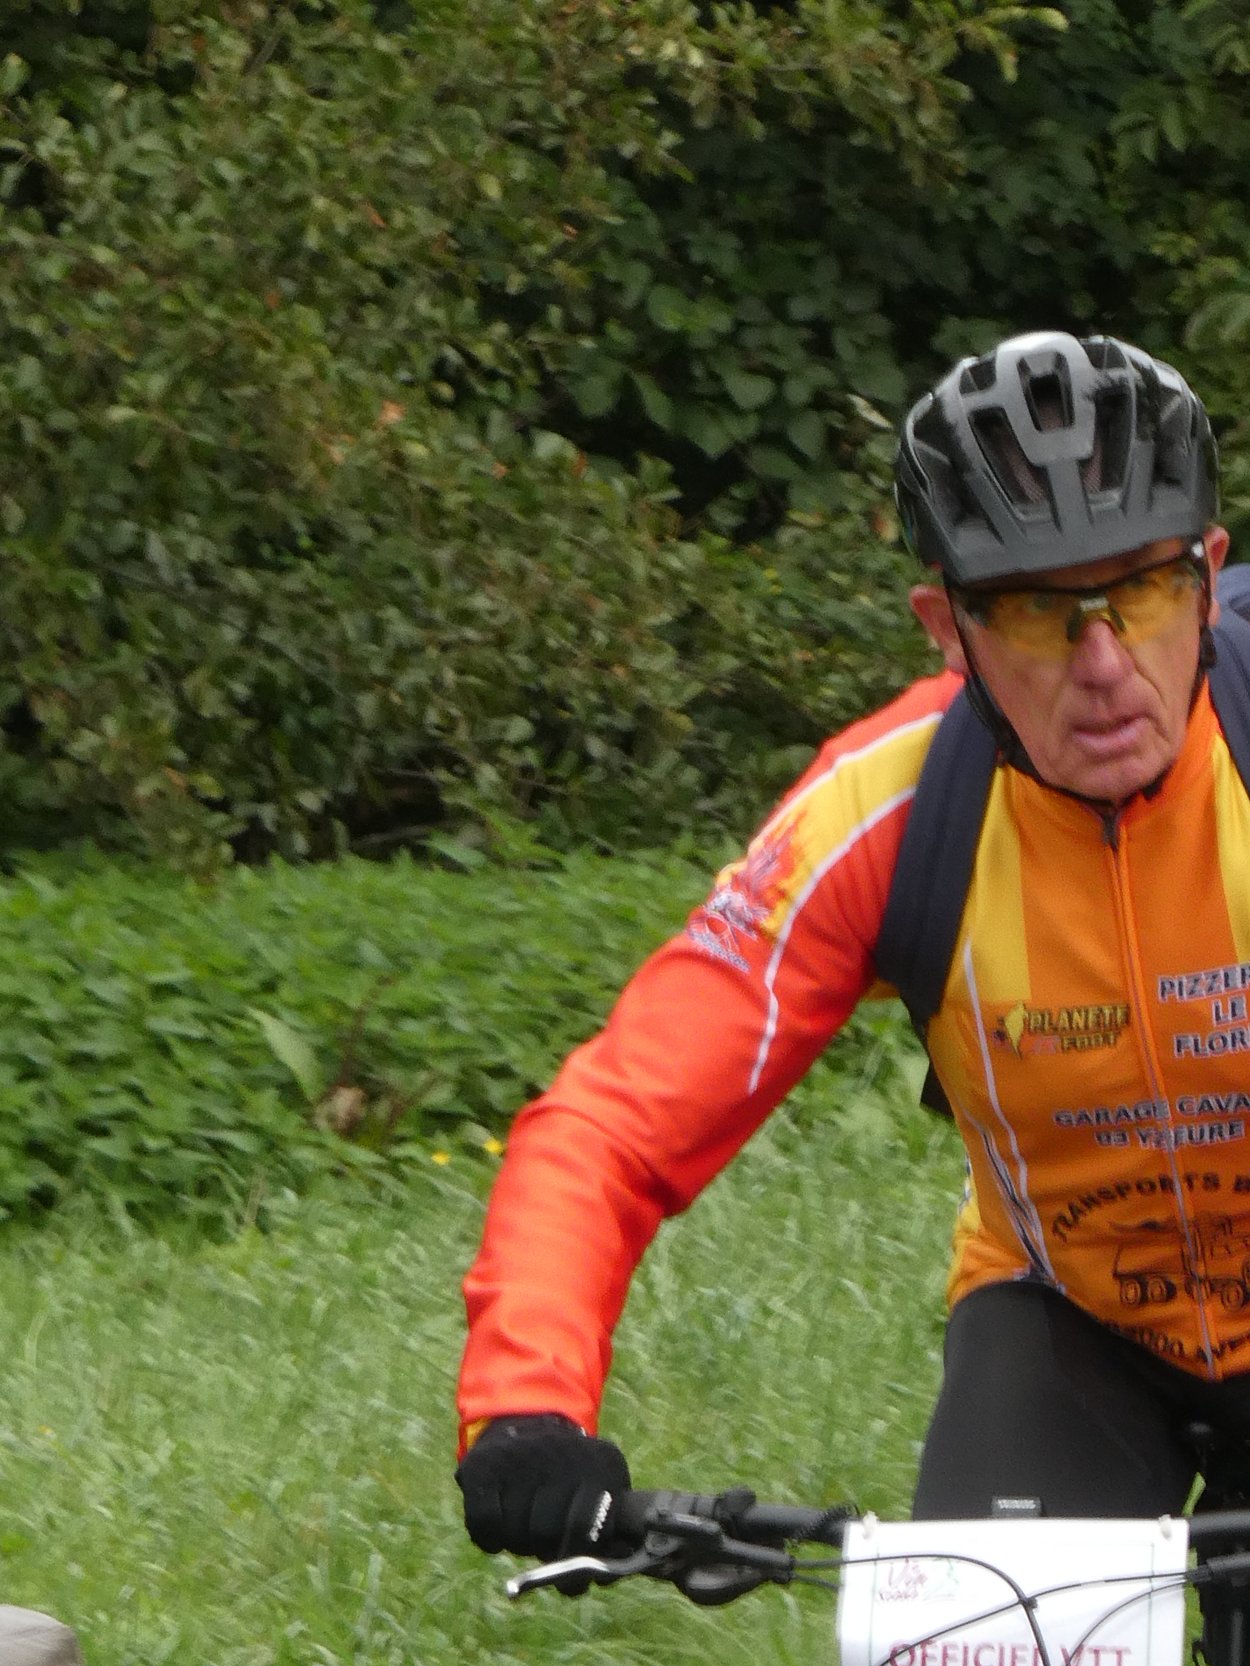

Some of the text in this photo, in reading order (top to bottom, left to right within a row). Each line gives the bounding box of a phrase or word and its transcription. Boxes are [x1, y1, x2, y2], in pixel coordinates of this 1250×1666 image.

[1212, 994, 1247, 1026] LE
[1053, 1099, 1169, 1127] GARAGE
[1051, 1172, 1220, 1242] TRANSPORTS
